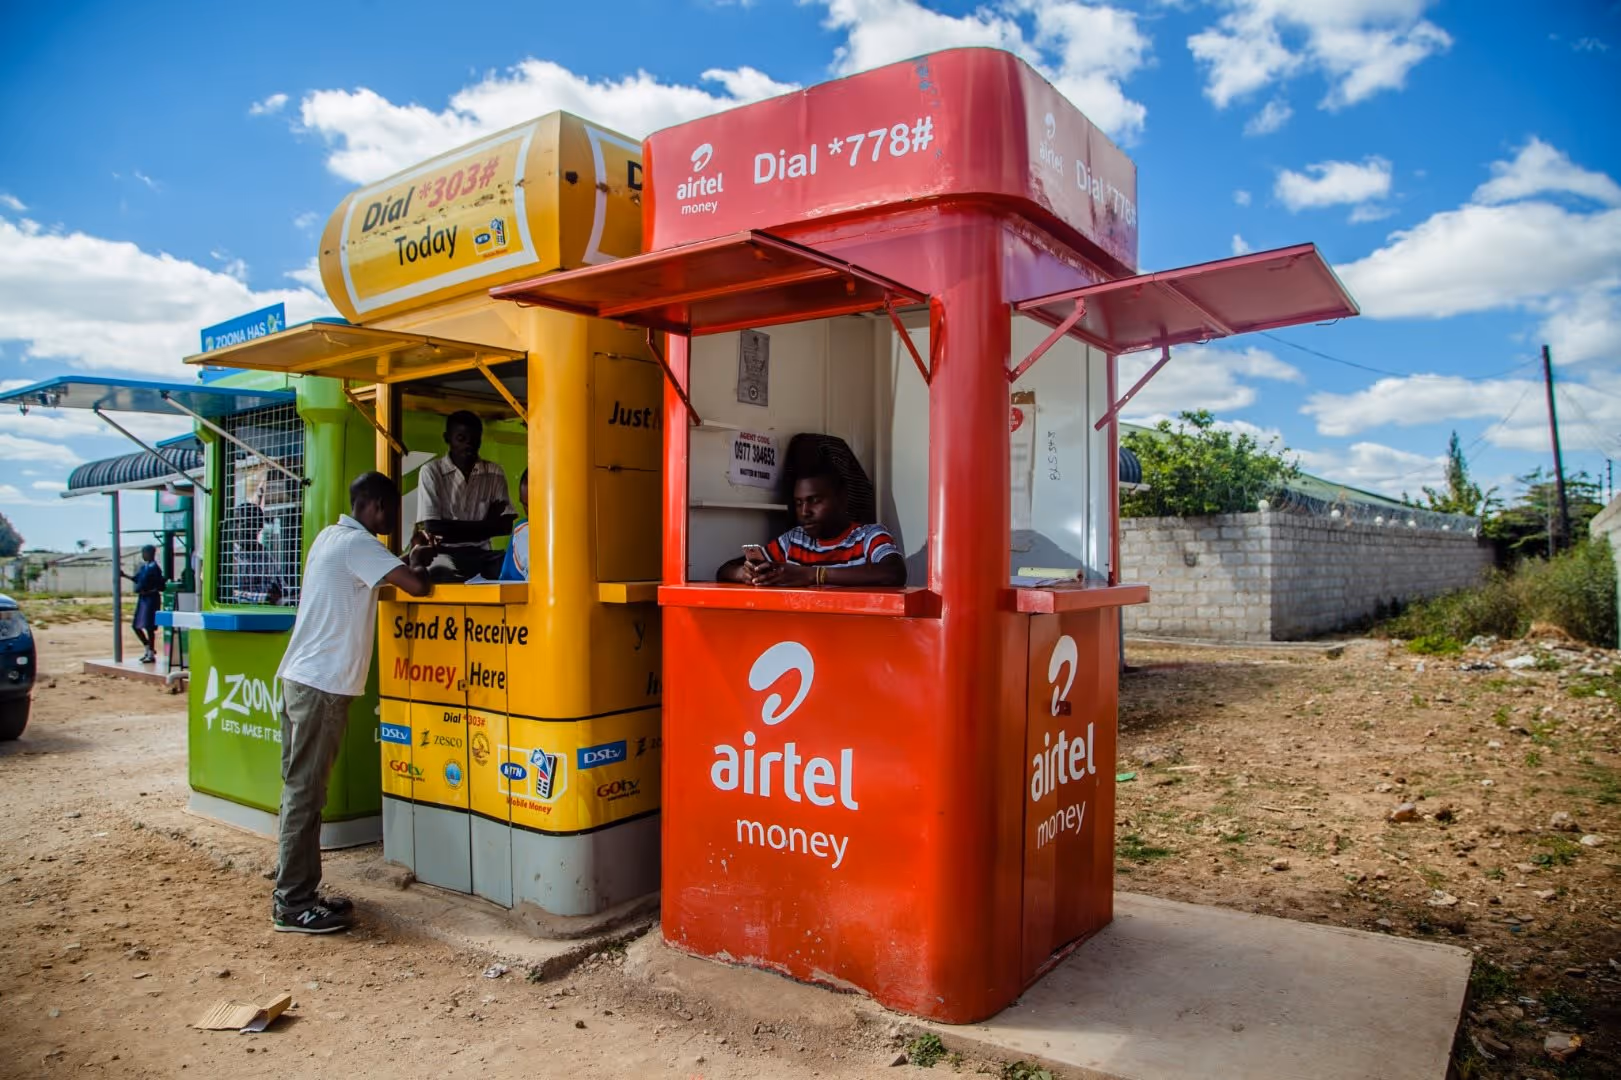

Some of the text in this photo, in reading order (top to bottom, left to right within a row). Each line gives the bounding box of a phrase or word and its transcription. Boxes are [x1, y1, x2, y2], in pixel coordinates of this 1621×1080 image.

[753, 144, 817, 185] Dial
[676, 172, 724, 200] airtel
[1075, 159, 1104, 204] Dial
[362, 186, 416, 233] Dial
[681, 200, 718, 215] money
[394, 225, 458, 266] Today
[215, 321, 266, 350] ZOONA HAS
[608, 401, 652, 429] Just
[393, 615, 529, 645] Send & Receive
[393, 656, 506, 691] Money Here
[221, 718, 241, 735] LET'S
[242, 722, 263, 739] MAKE
[264, 728, 273, 742] IT
[443, 712, 462, 724] Dial
[381, 727, 409, 741] DStv
[433, 734, 463, 749] zesco
[389, 760, 425, 777] GOtv
[583, 748, 622, 764] DStv
[1031, 721, 1097, 802] airtel
[503, 764, 524, 778] MTN
[711, 730, 859, 811] airtel
[596, 779, 641, 798] GOtv
[506, 796, 553, 815] Mobile Money
[1037, 801, 1087, 849] money
[737, 818, 849, 869] money
